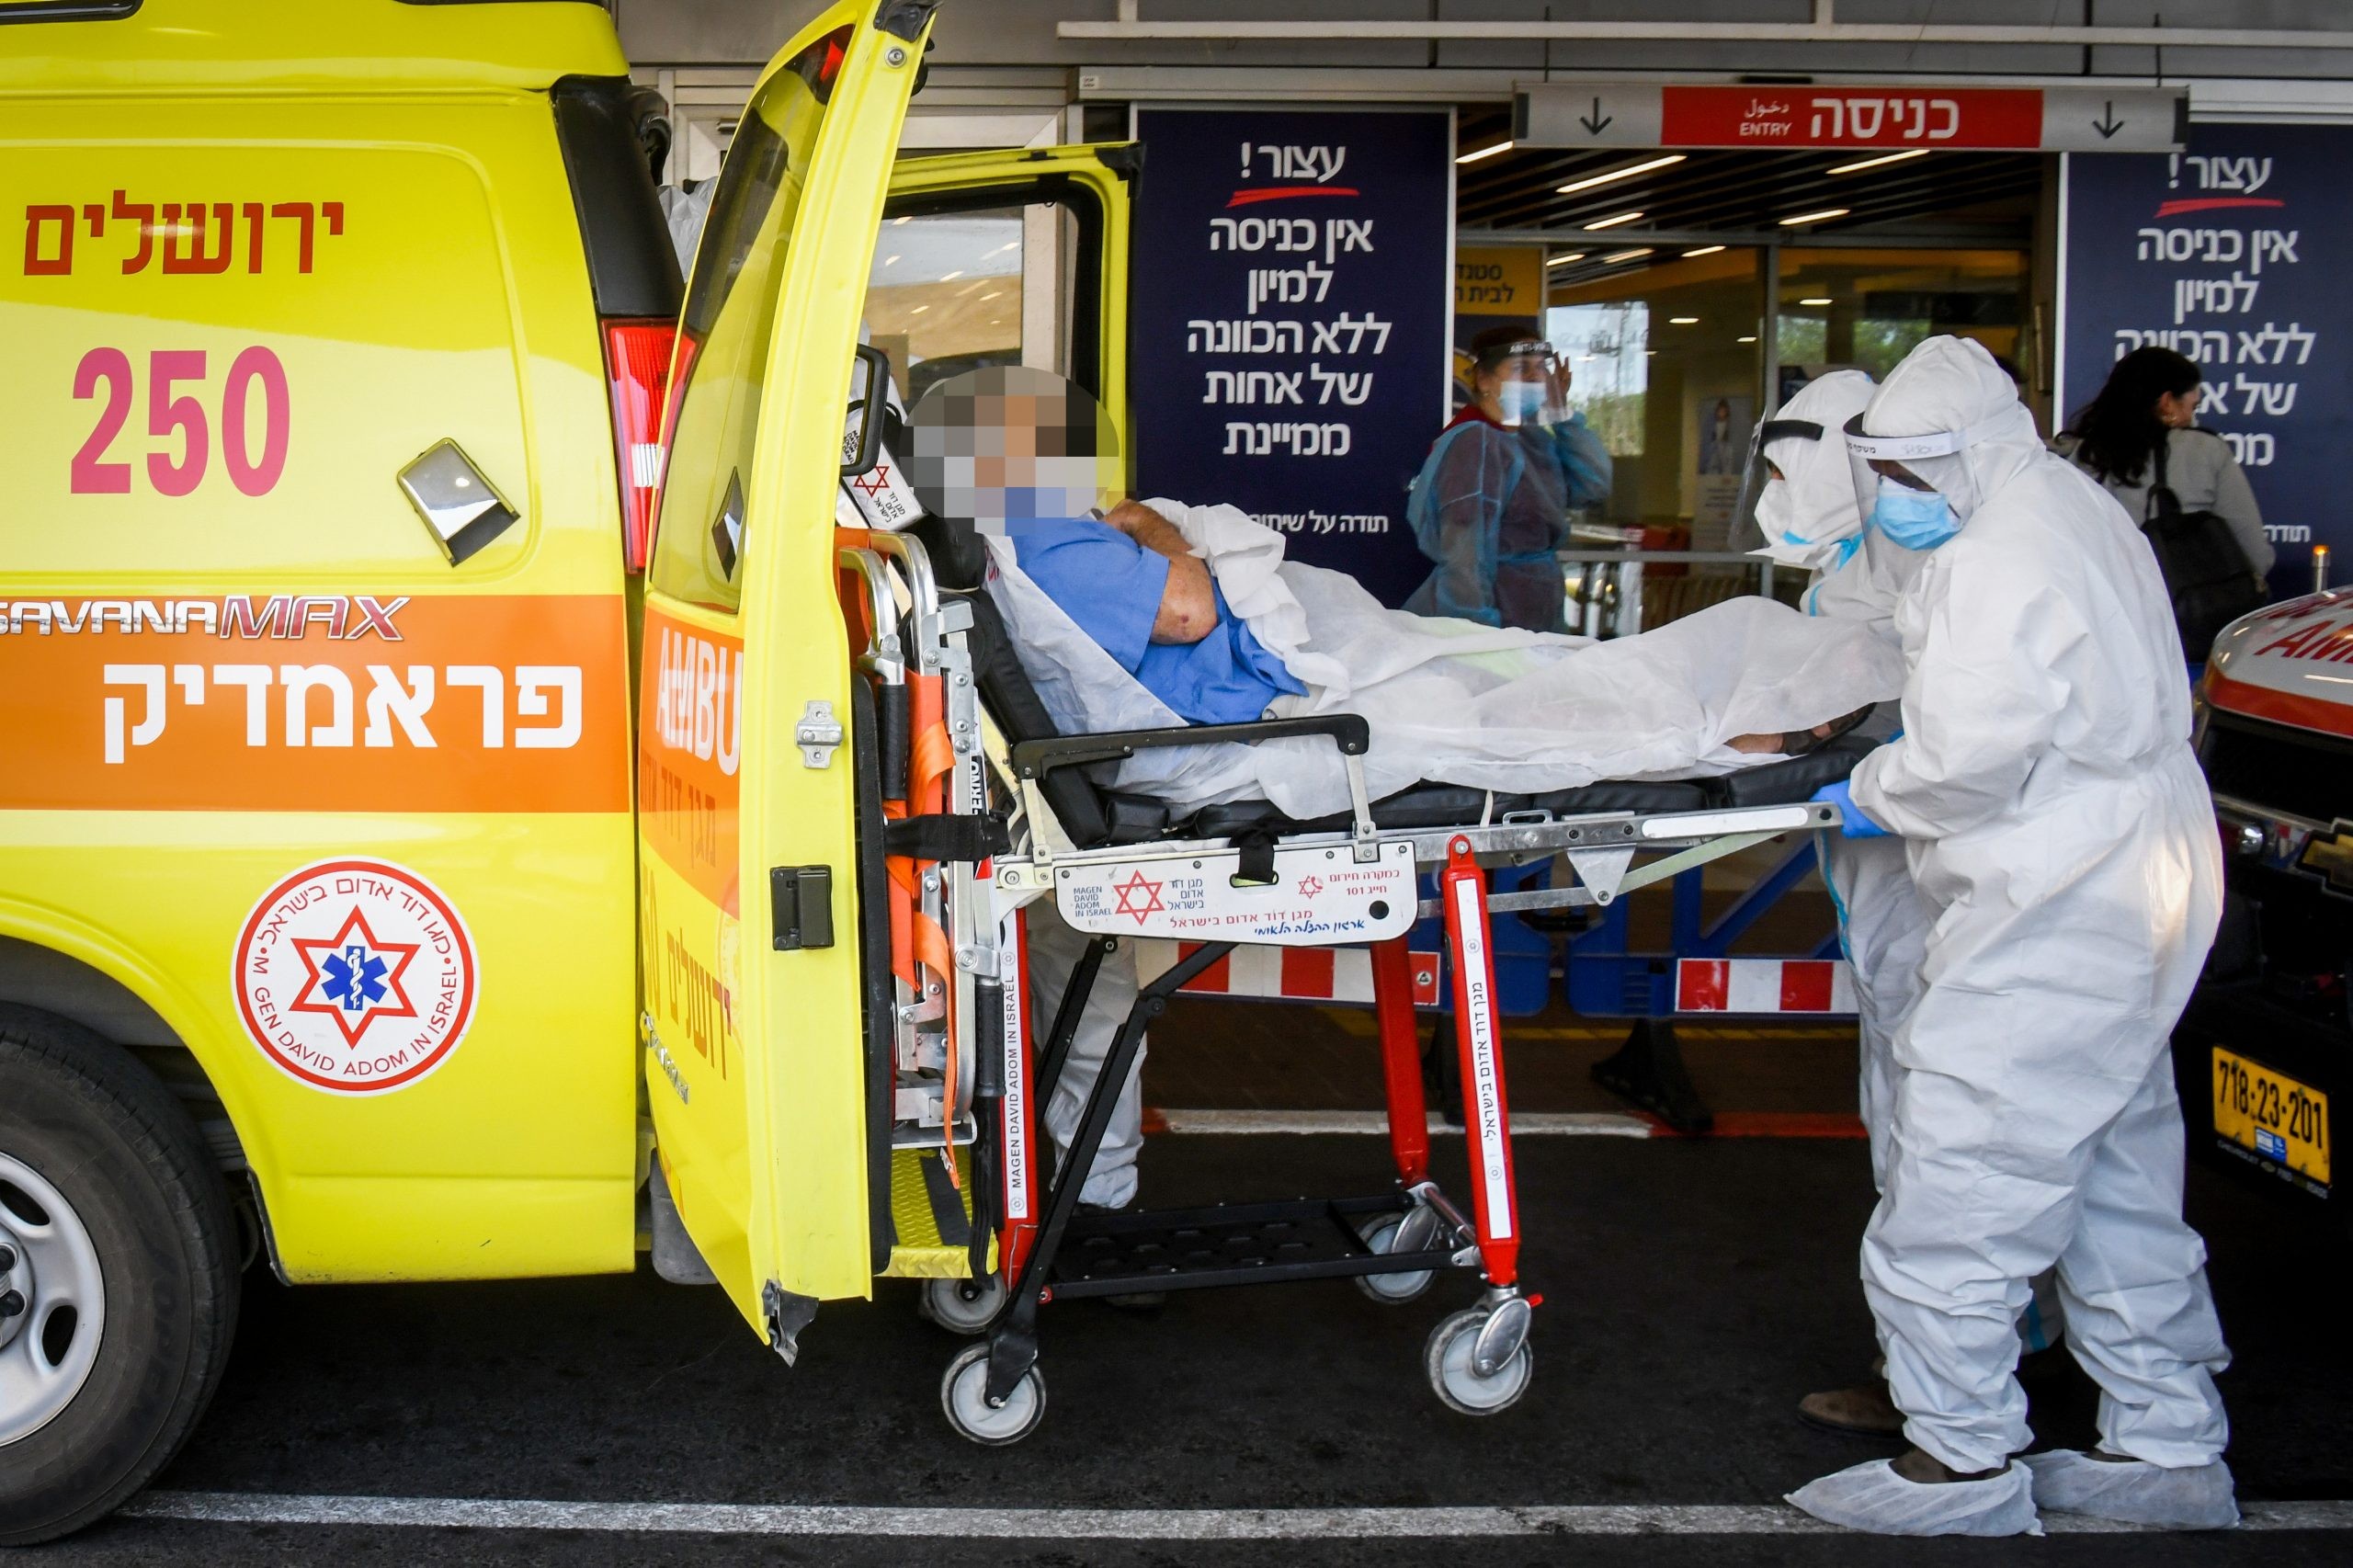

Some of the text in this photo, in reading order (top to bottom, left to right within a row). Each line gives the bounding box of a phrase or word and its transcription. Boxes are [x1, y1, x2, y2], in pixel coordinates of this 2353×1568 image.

[1740, 122, 1791, 136] ENTRY
[1744, 98, 1790, 119] دخول
[1810, 97, 1960, 139] כניסה
[24, 189, 344, 275] ירושלים
[1210, 218, 1374, 265] אין כניסה
[2137, 228, 2300, 275] אין כניסה
[1247, 260, 1335, 314] למיון
[1468, 281, 1516, 304] לבית
[2175, 270, 2260, 324] למיון
[1188, 312, 1392, 354] ללא הכוונה
[2236, 322, 2316, 365] ללא
[1203, 362, 1374, 405] של אחות
[2235, 372, 2298, 416] של
[71, 345, 290, 497] 250
[1222, 422, 1351, 456] ממיינת
[1308, 509, 1336, 535] על
[1338, 515, 1389, 533] תודה
[104, 664, 583, 764] פראמדיק
[1074, 885, 1102, 895] MAGEN
[1074, 894, 1099, 903] DAVID
[1180, 890, 1204, 900] אדום
[1188, 879, 1203, 889] מגן
[1347, 887, 1365, 896] 101
[257, 878, 450, 954] מגן דוד אדום בישראל
[1075, 907, 1113, 917] IN ISRAEL
[1167, 900, 1205, 912] בישראל
[1170, 916, 1220, 929] בישראל
[1226, 914, 1257, 925] אדום
[1291, 910, 1313, 920] מגן
[278, 1030, 335, 1072] DAVID
[343, 1050, 409, 1075] ADOM
[410, 1032, 432, 1055] IN
[426, 966, 457, 1035] ISRAEL
[666, 926, 732, 1081] ירושלים
[1006, 975, 1021, 1188] MAGEN DAVID ADOM IN ISRAEL
[1472, 983, 1496, 1138] מגן דוד אדום בישראל
